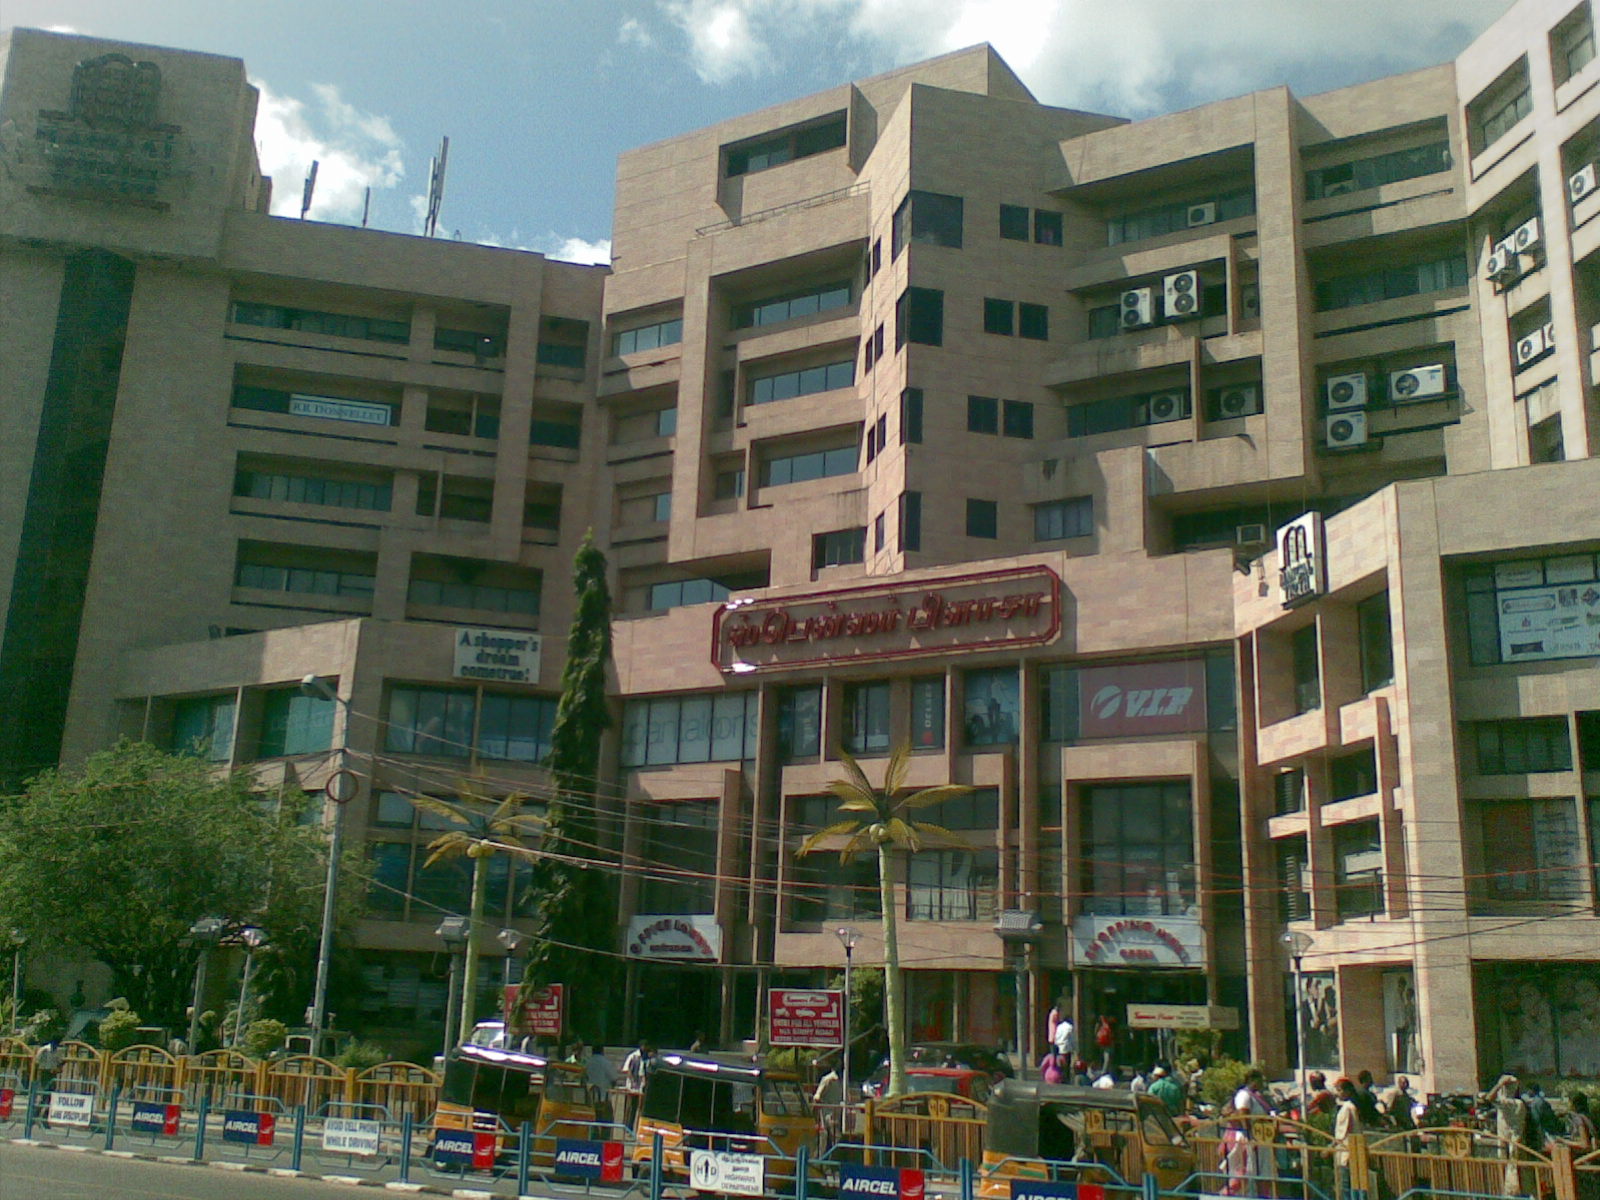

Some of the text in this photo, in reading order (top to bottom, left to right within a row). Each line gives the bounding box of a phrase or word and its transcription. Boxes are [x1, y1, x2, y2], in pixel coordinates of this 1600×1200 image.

[459, 630, 472, 647] A
[57, 1096, 86, 1108] FOLLOW
[134, 1111, 164, 1124] AIRCEL
[224, 1120, 258, 1134] AIRCEL
[326, 1136, 347, 1148] WHILE
[435, 1139, 474, 1154] AIRCEL
[556, 1151, 602, 1165] AIRCEL
[842, 1177, 898, 1196] AIRCEL
